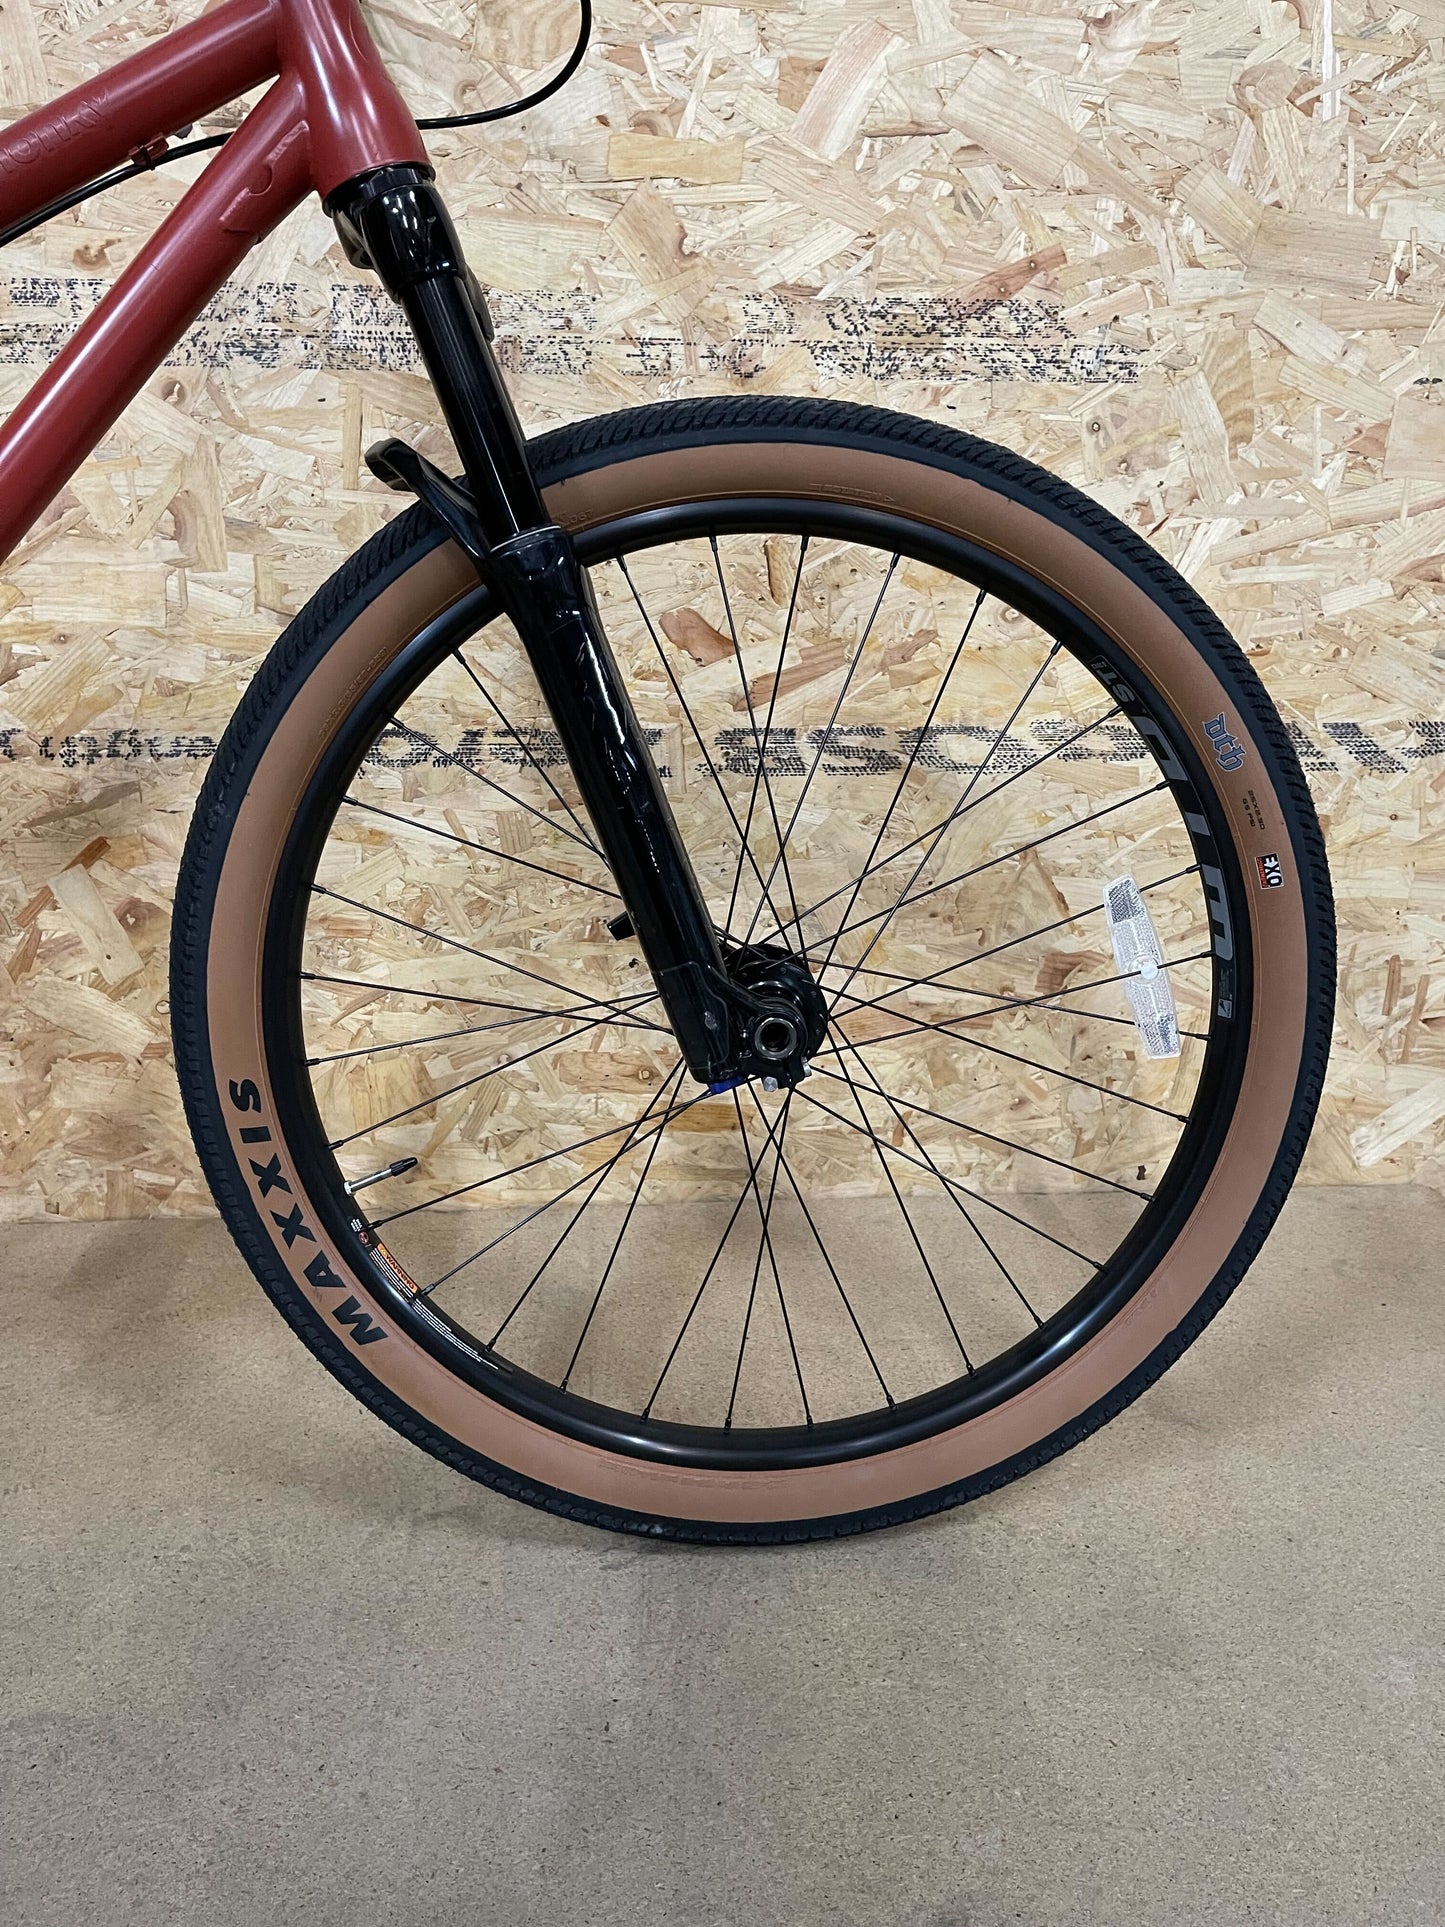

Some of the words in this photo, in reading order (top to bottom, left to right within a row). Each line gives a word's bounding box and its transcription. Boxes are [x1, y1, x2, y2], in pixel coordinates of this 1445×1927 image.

[1263, 853, 1283, 888] EXO
[229, 1079, 389, 1346] MAXXIS
[385, 1252, 416, 1290] WARNING
